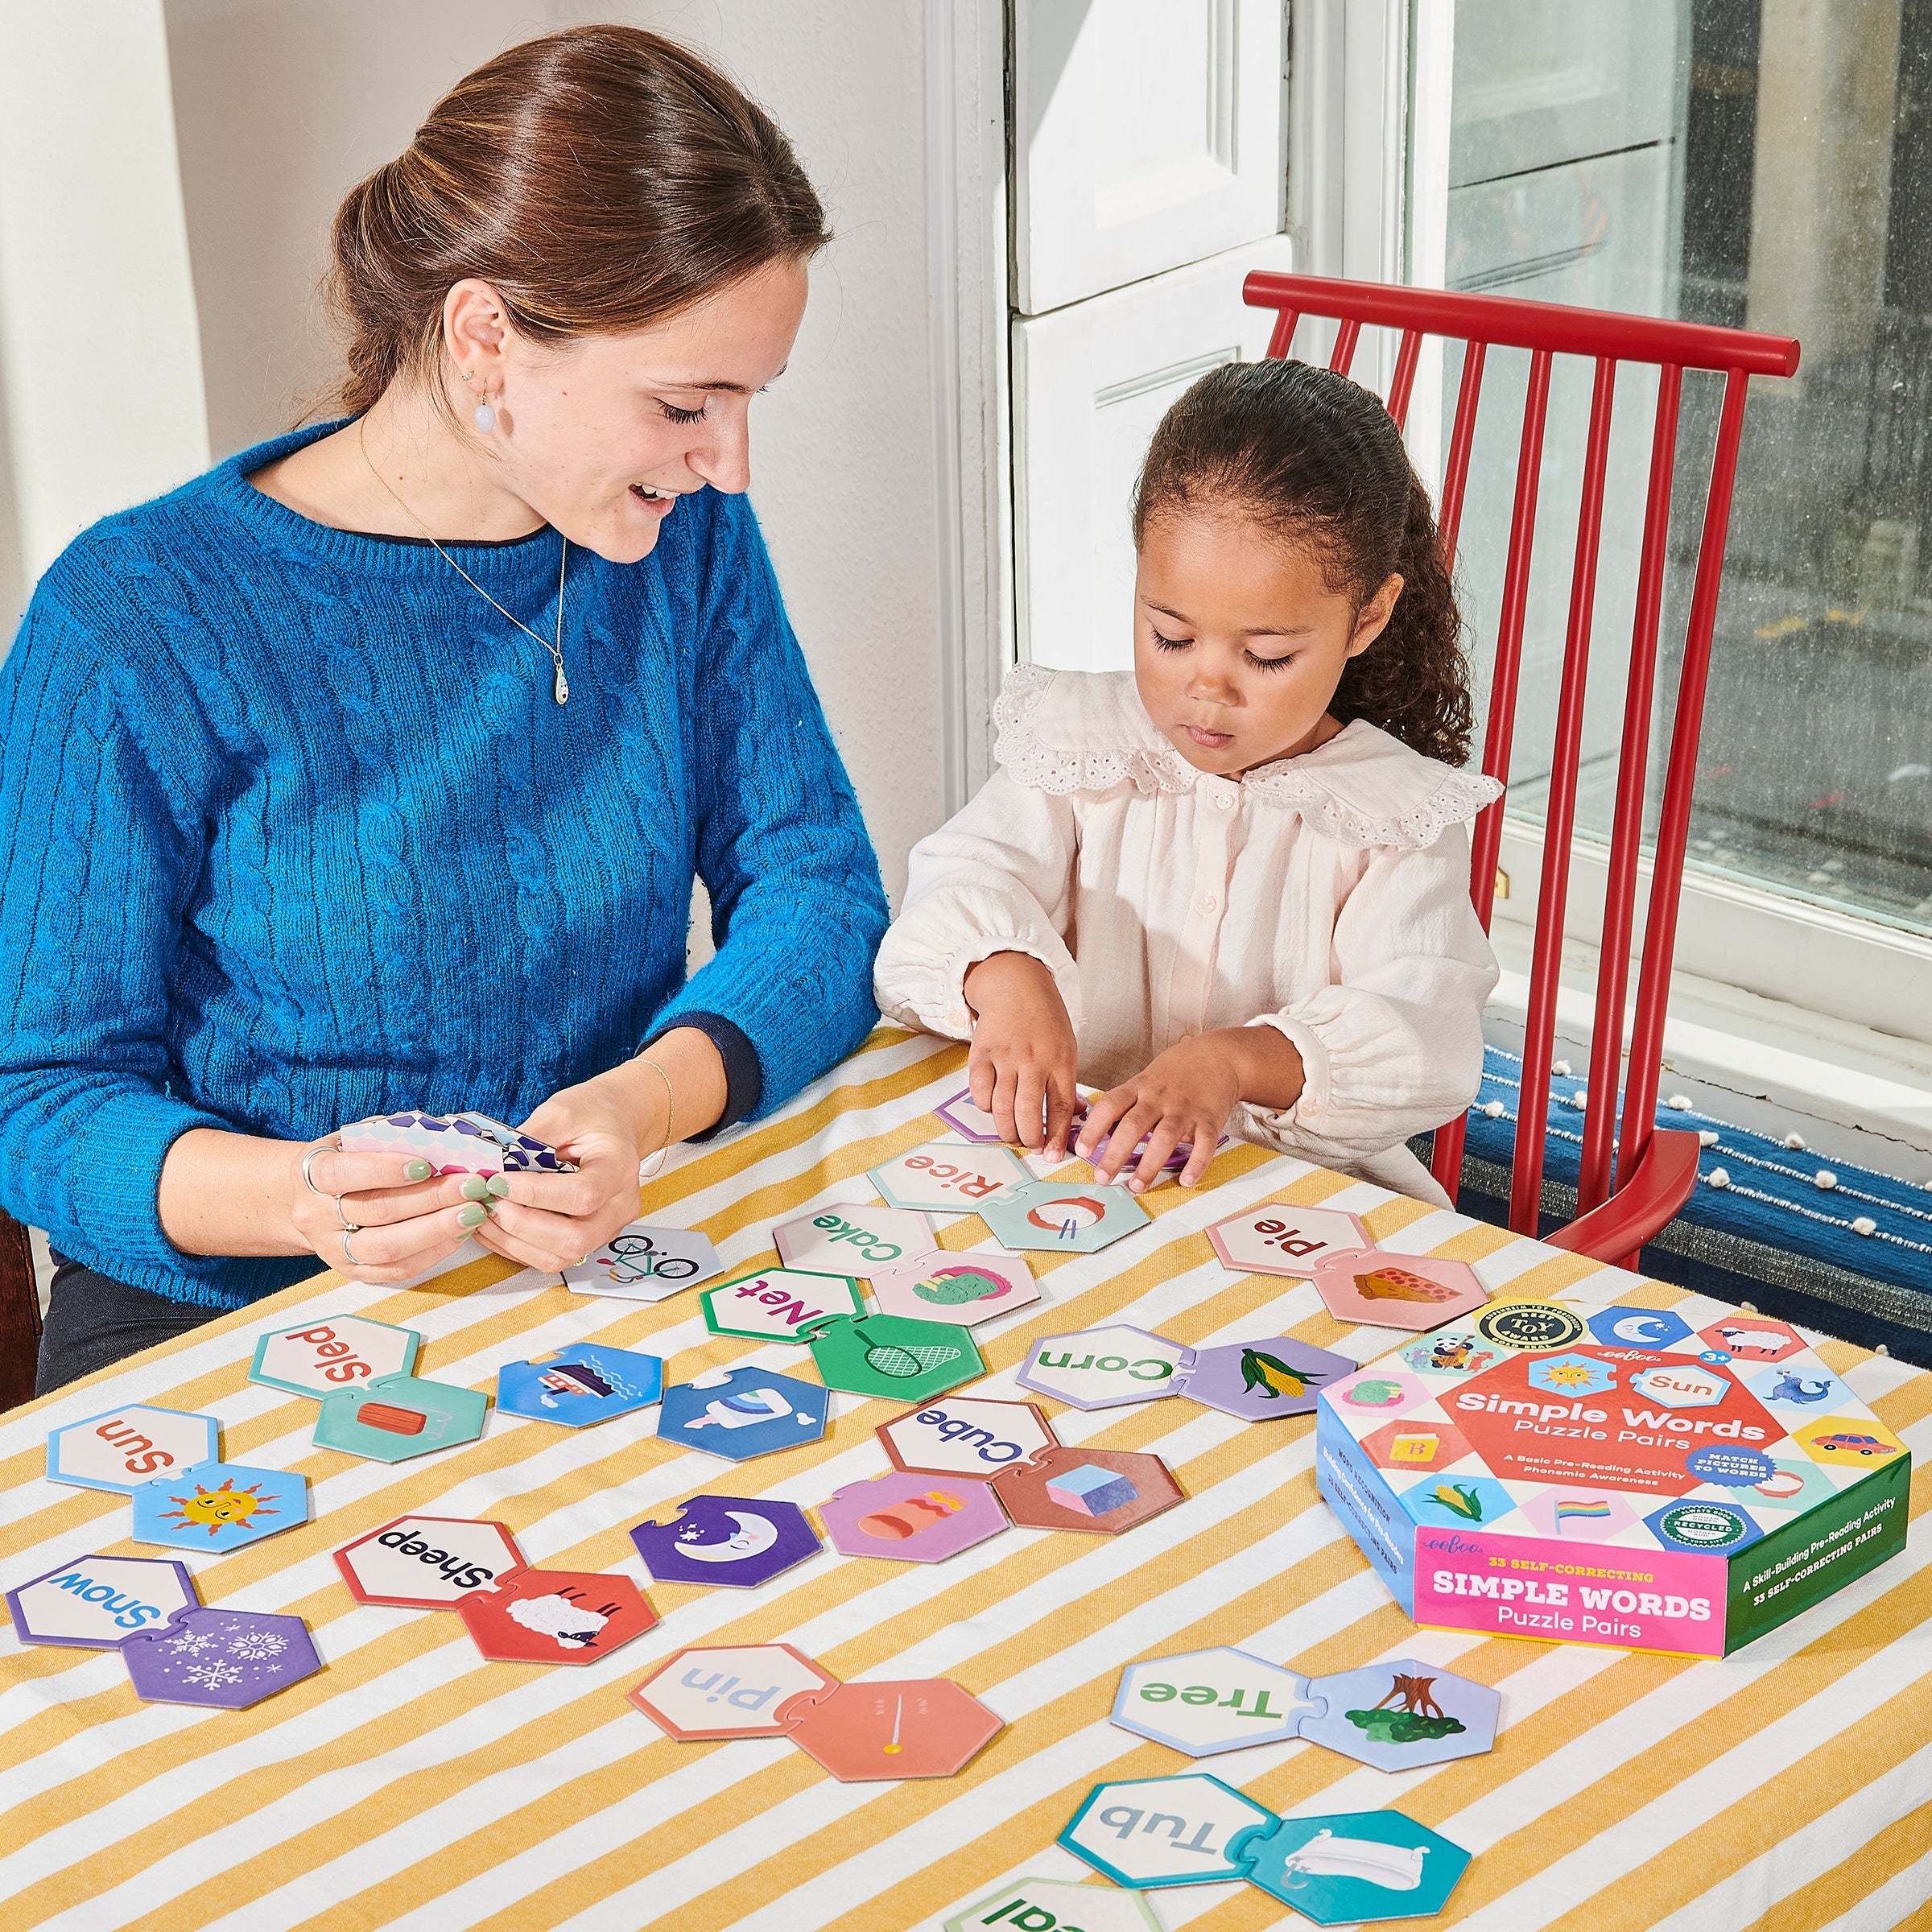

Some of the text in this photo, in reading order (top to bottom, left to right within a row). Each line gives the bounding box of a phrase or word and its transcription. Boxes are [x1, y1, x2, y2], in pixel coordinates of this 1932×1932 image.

[904, 1154, 1005, 1198] Rice
[813, 1214, 902, 1261] Cake
[1254, 1218, 1327, 1257] Pie
[734, 1280, 824, 1327] Net
[1521, 1312, 1554, 1321] BEST
[1501, 1330, 1550, 1342] AWARD
[1511, 1319, 1554, 1334] TOY
[286, 1325, 371, 1384] Sled
[1038, 1351, 1171, 1380] Corn
[1703, 1352, 1728, 1362] 3+
[1649, 1376, 1713, 1397] Sun
[915, 1409, 1022, 1462] Cube
[1455, 1392, 1765, 1441] Simple Words
[1513, 1420, 1690, 1450] Puzzle Pairs
[96, 1419, 174, 1474] Sun
[1697, 1459, 1766, 1472] PICTURES
[1709, 1454, 1758, 1464] MATCH
[1517, 1455, 1550, 1465] Basic
[1554, 1459, 1631, 1474] Pre-Reading
[1634, 1466, 1686, 1480] Activity
[1523, 1466, 1658, 1486] Phonemic Awareness
[1717, 1468, 1767, 1478] WORDS
[1674, 1521, 1732, 1532] RECYCLED
[1743, 1496, 1896, 1593] A Skill-Building Pre-Reading Activity
[378, 1531, 493, 1591] Sheep
[1488, 1556, 1654, 1583] 33 SELF-CORRECTING
[1753, 1523, 1883, 1606] 33 SELF-CORRECTING PAIRS
[48, 1572, 161, 1631] Snow
[1433, 1570, 1711, 1621] SIMPLE WORDS
[1498, 1605, 1641, 1638] Puzzle Pairs
[681, 1668, 781, 1711] Pin
[1140, 1680, 1282, 1719] Tree
[1099, 1806, 1217, 1855] Tub
